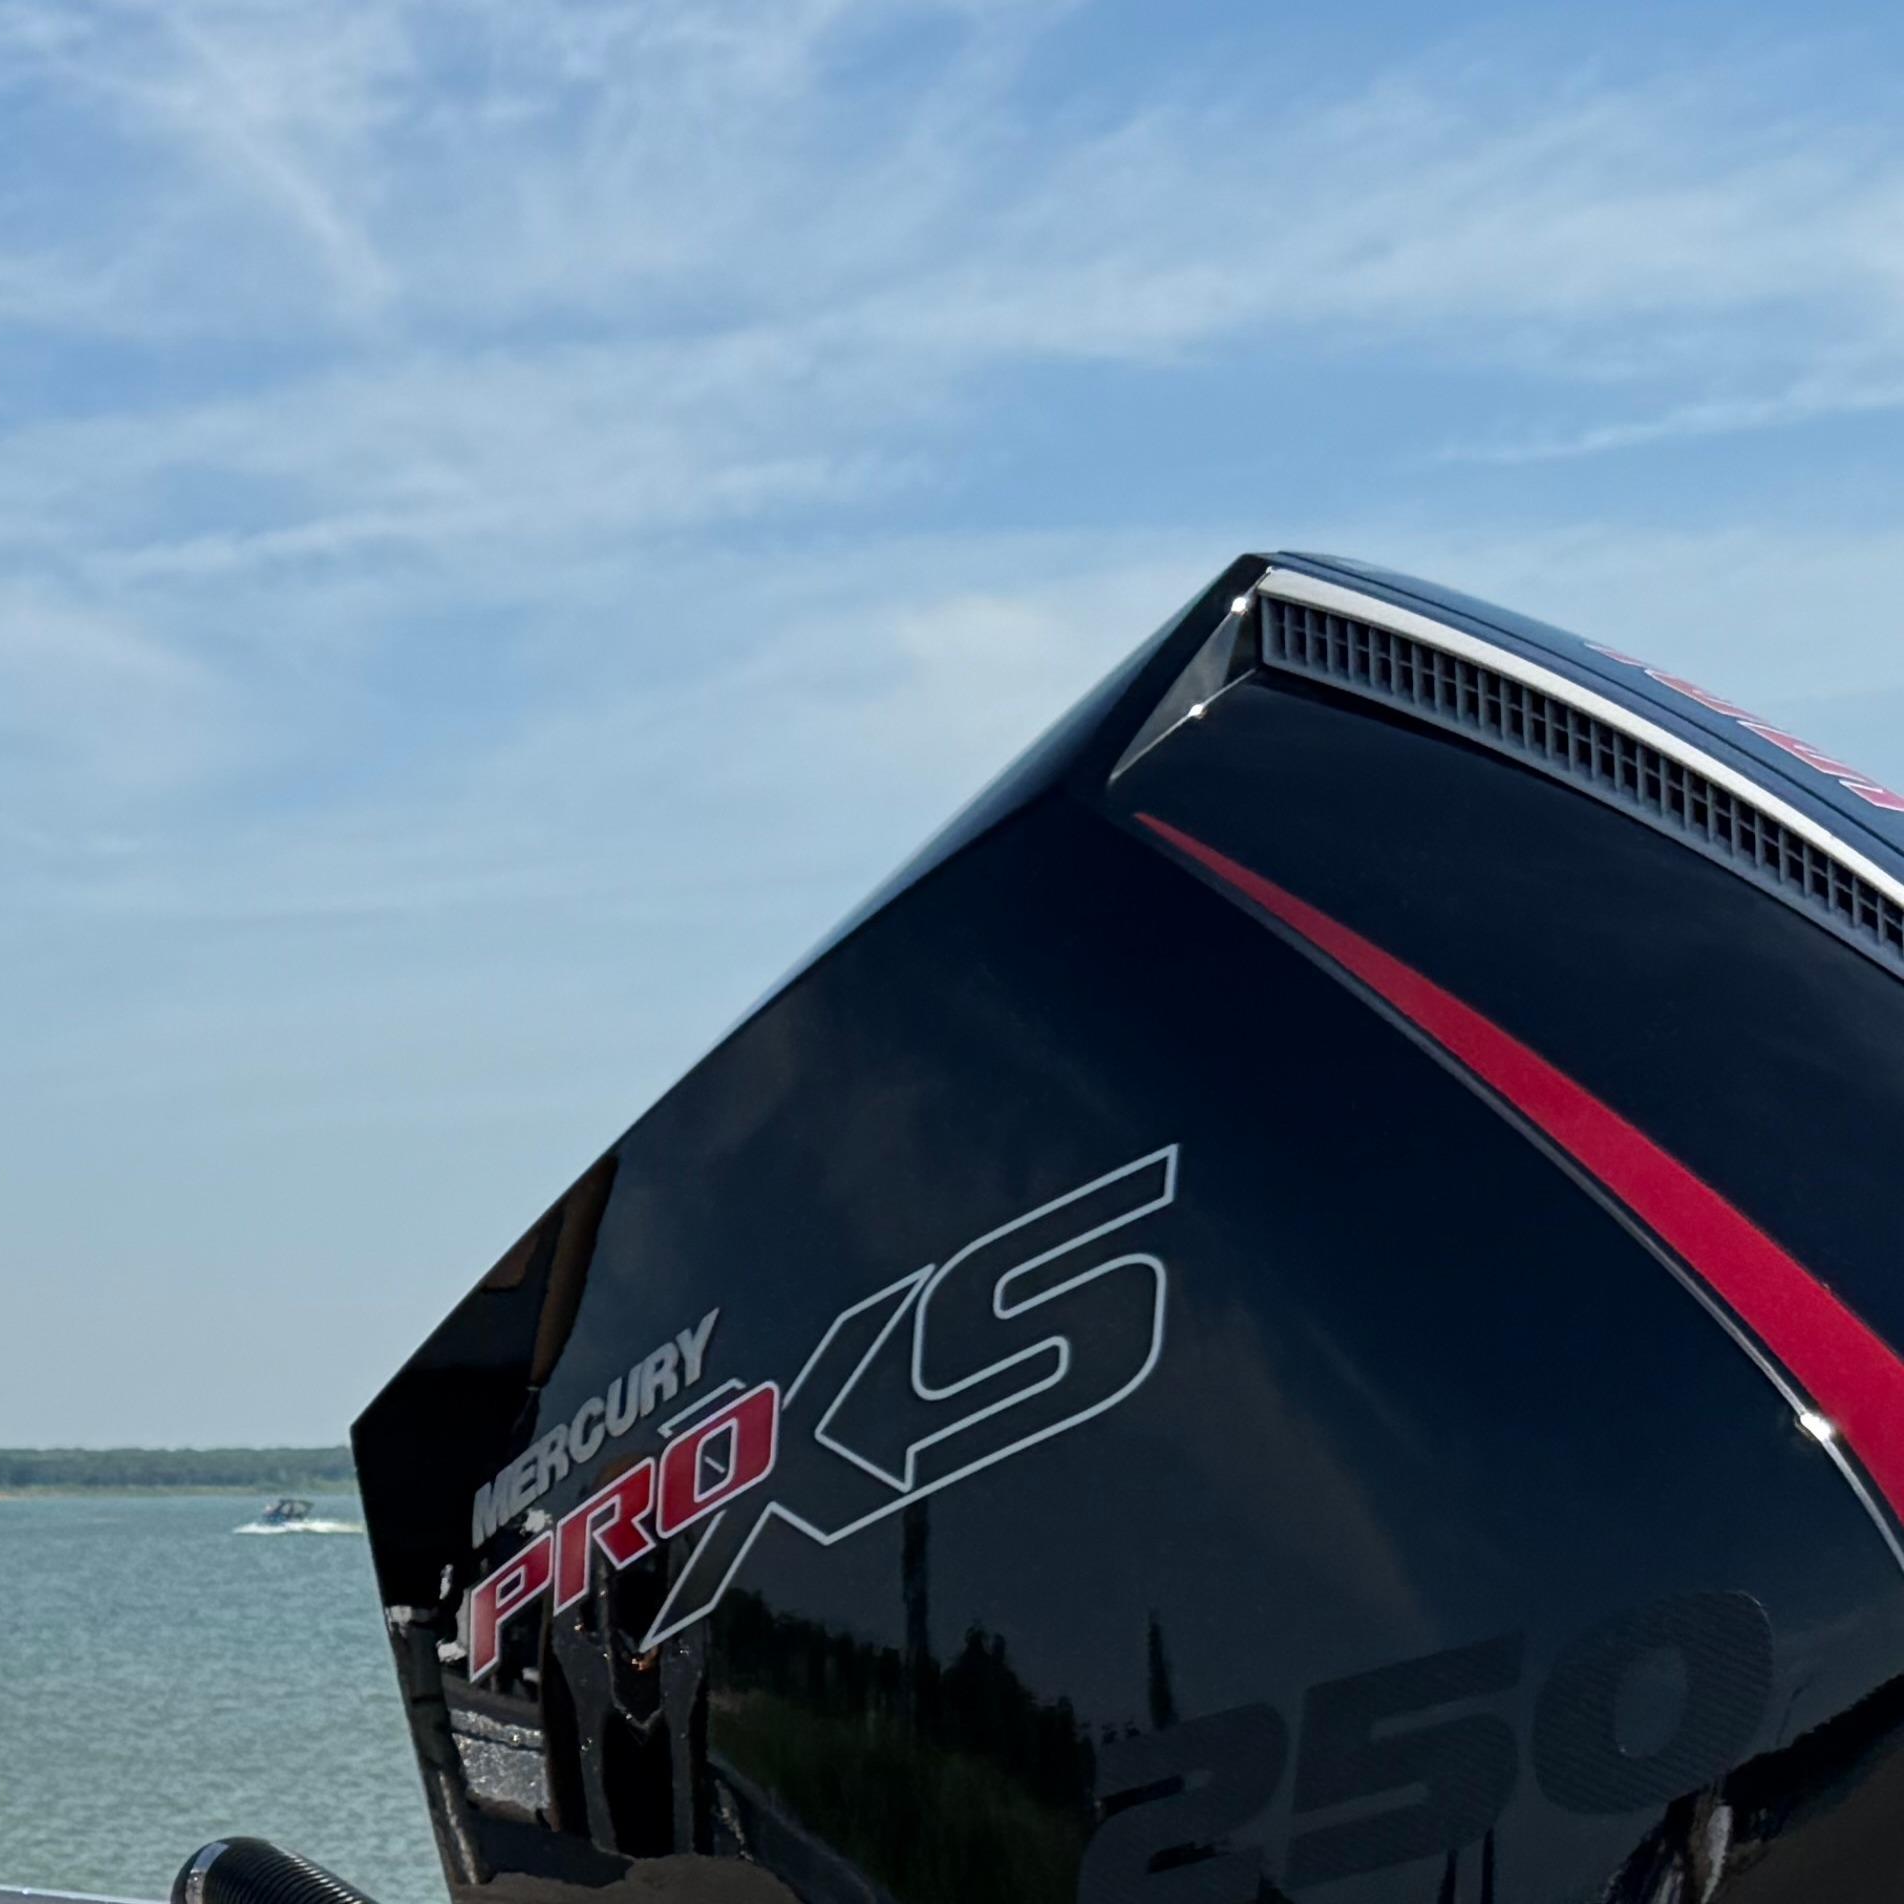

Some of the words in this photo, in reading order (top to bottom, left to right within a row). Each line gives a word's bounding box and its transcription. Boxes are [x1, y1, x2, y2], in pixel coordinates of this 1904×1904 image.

[469, 1380, 781, 1684] PRO
[639, 1142, 1180, 1652] XS
[472, 1307, 720, 1549] MERCURY
